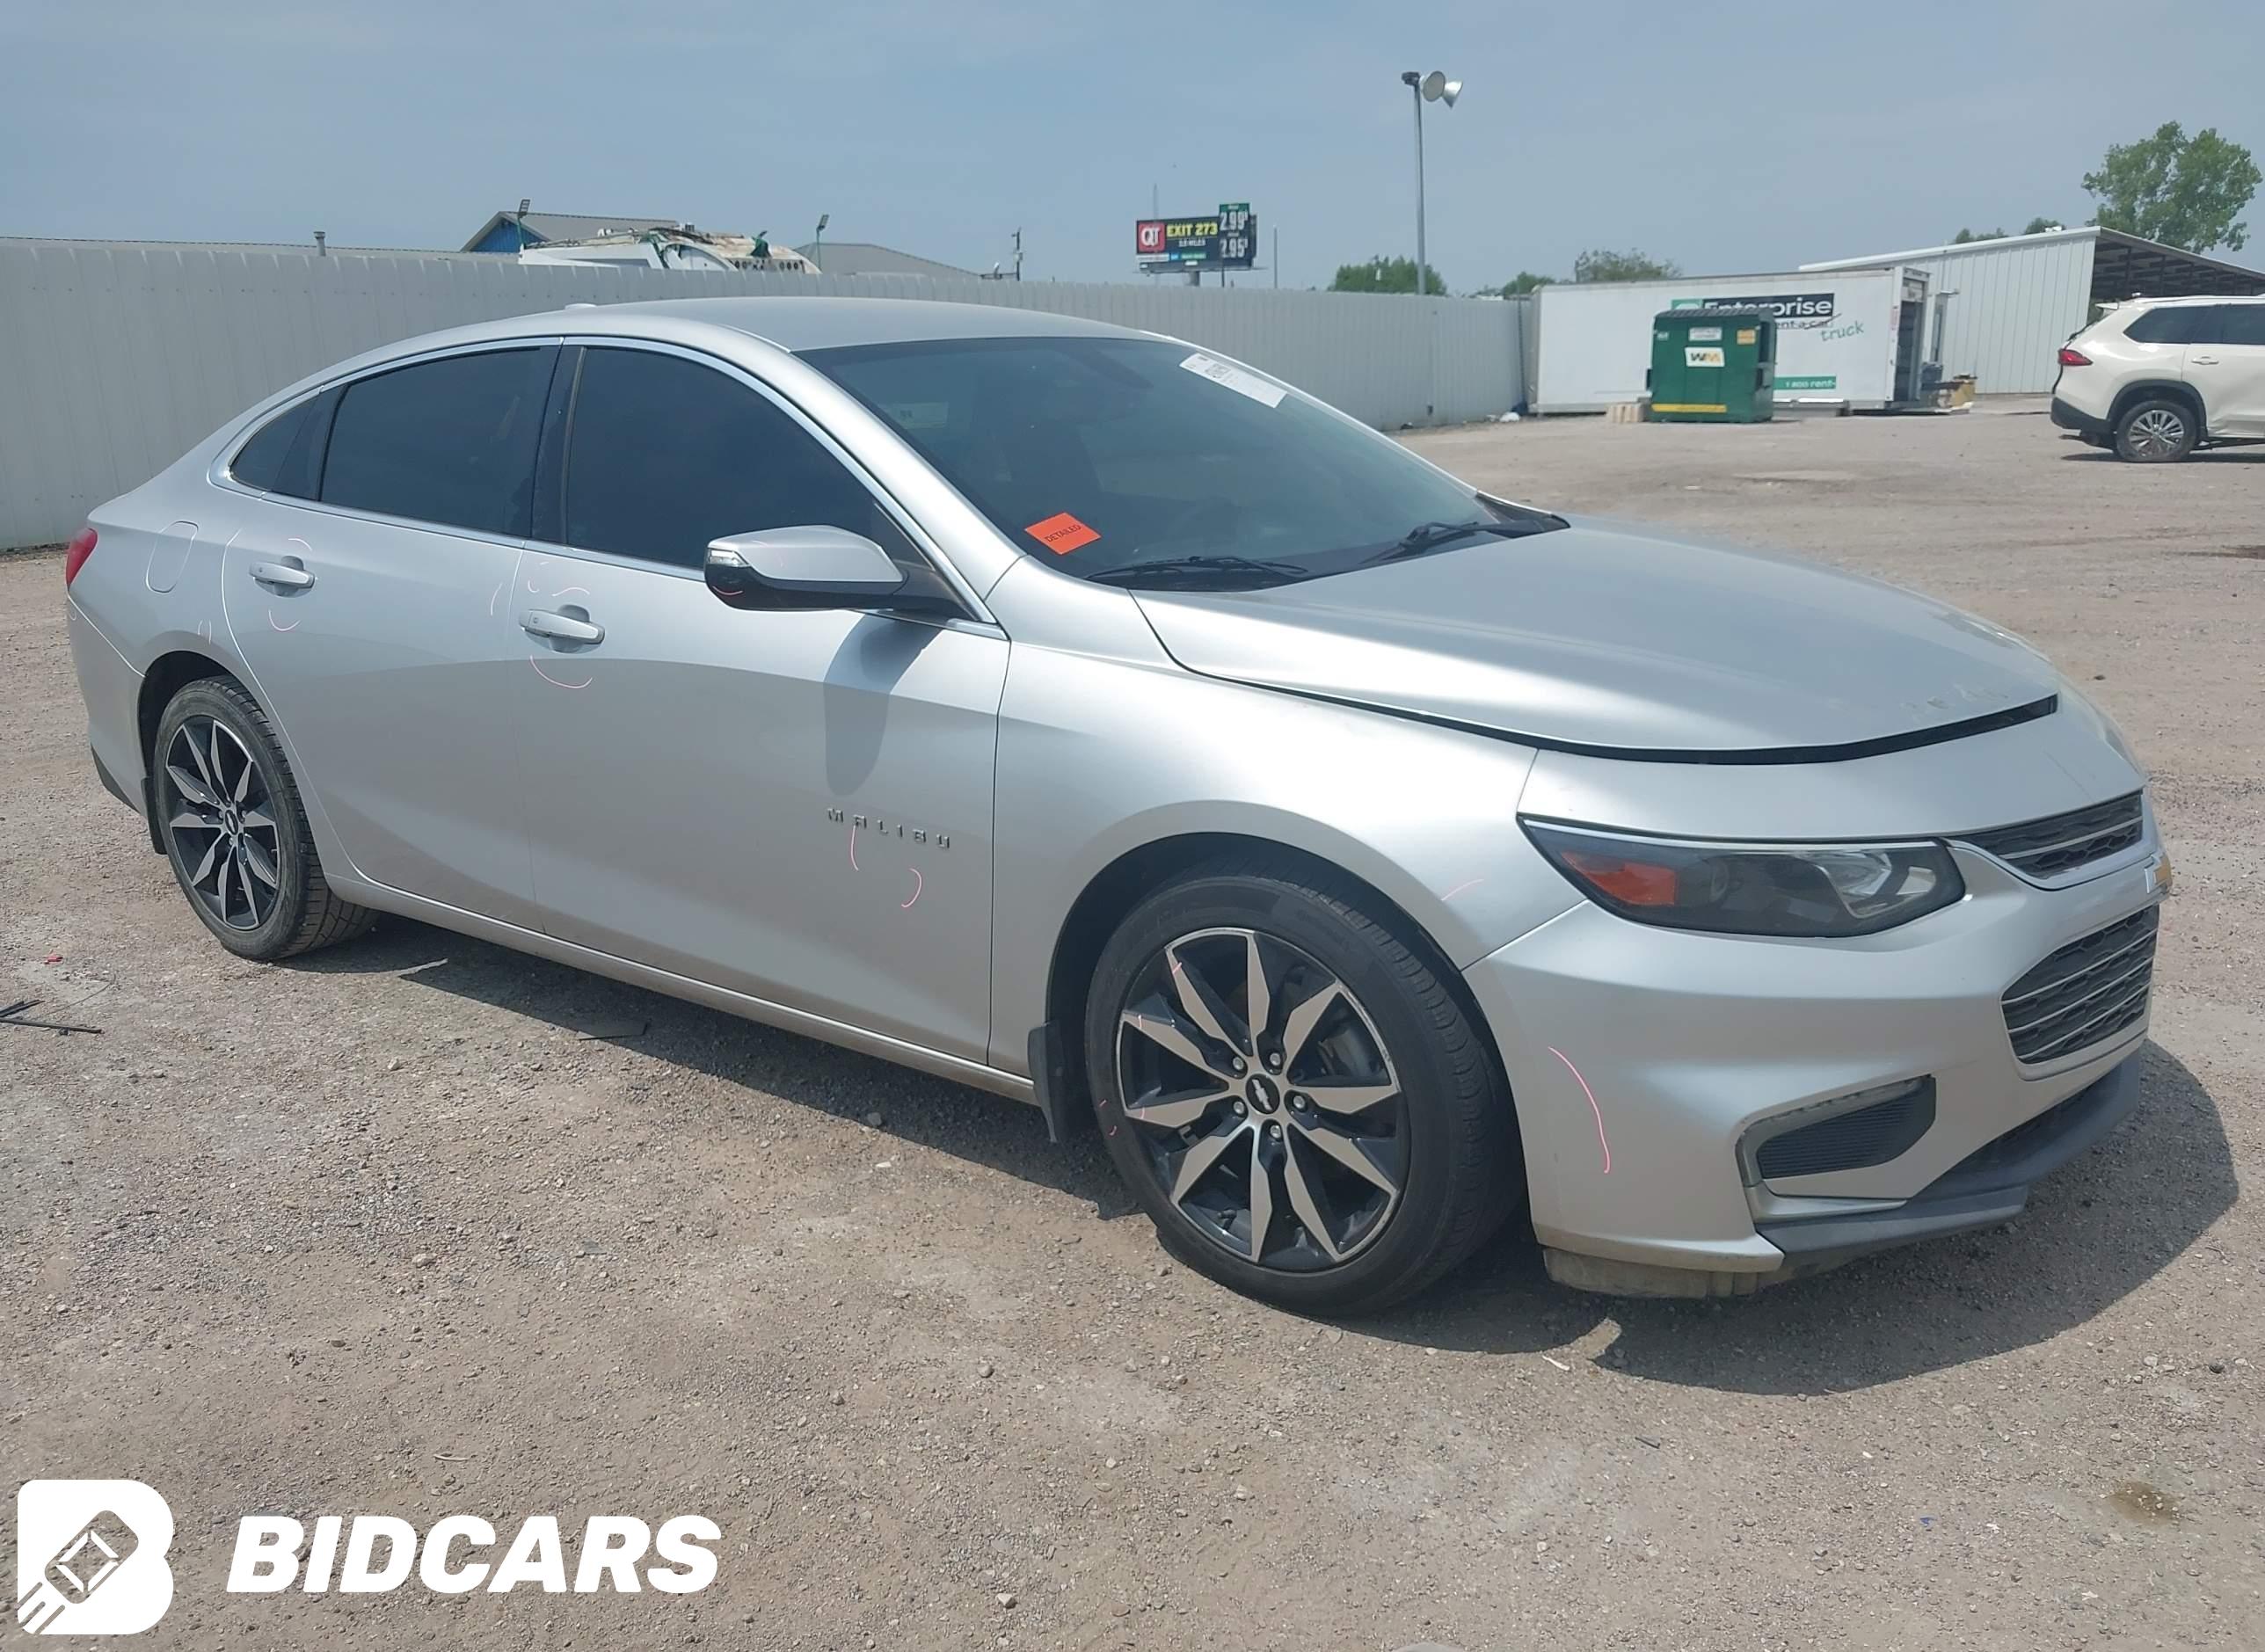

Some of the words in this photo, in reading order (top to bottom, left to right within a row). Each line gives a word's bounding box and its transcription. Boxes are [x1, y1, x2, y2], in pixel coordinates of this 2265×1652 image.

[1141, 227, 1160, 247] QT
[1166, 223, 1193, 237] EXIT
[1195, 222, 1218, 236] 273
[1820, 322, 1864, 341] truck
[1691, 353, 1721, 362] WM
[1045, 525, 1082, 542] DETAILED
[827, 807, 950, 849] MALIBU
